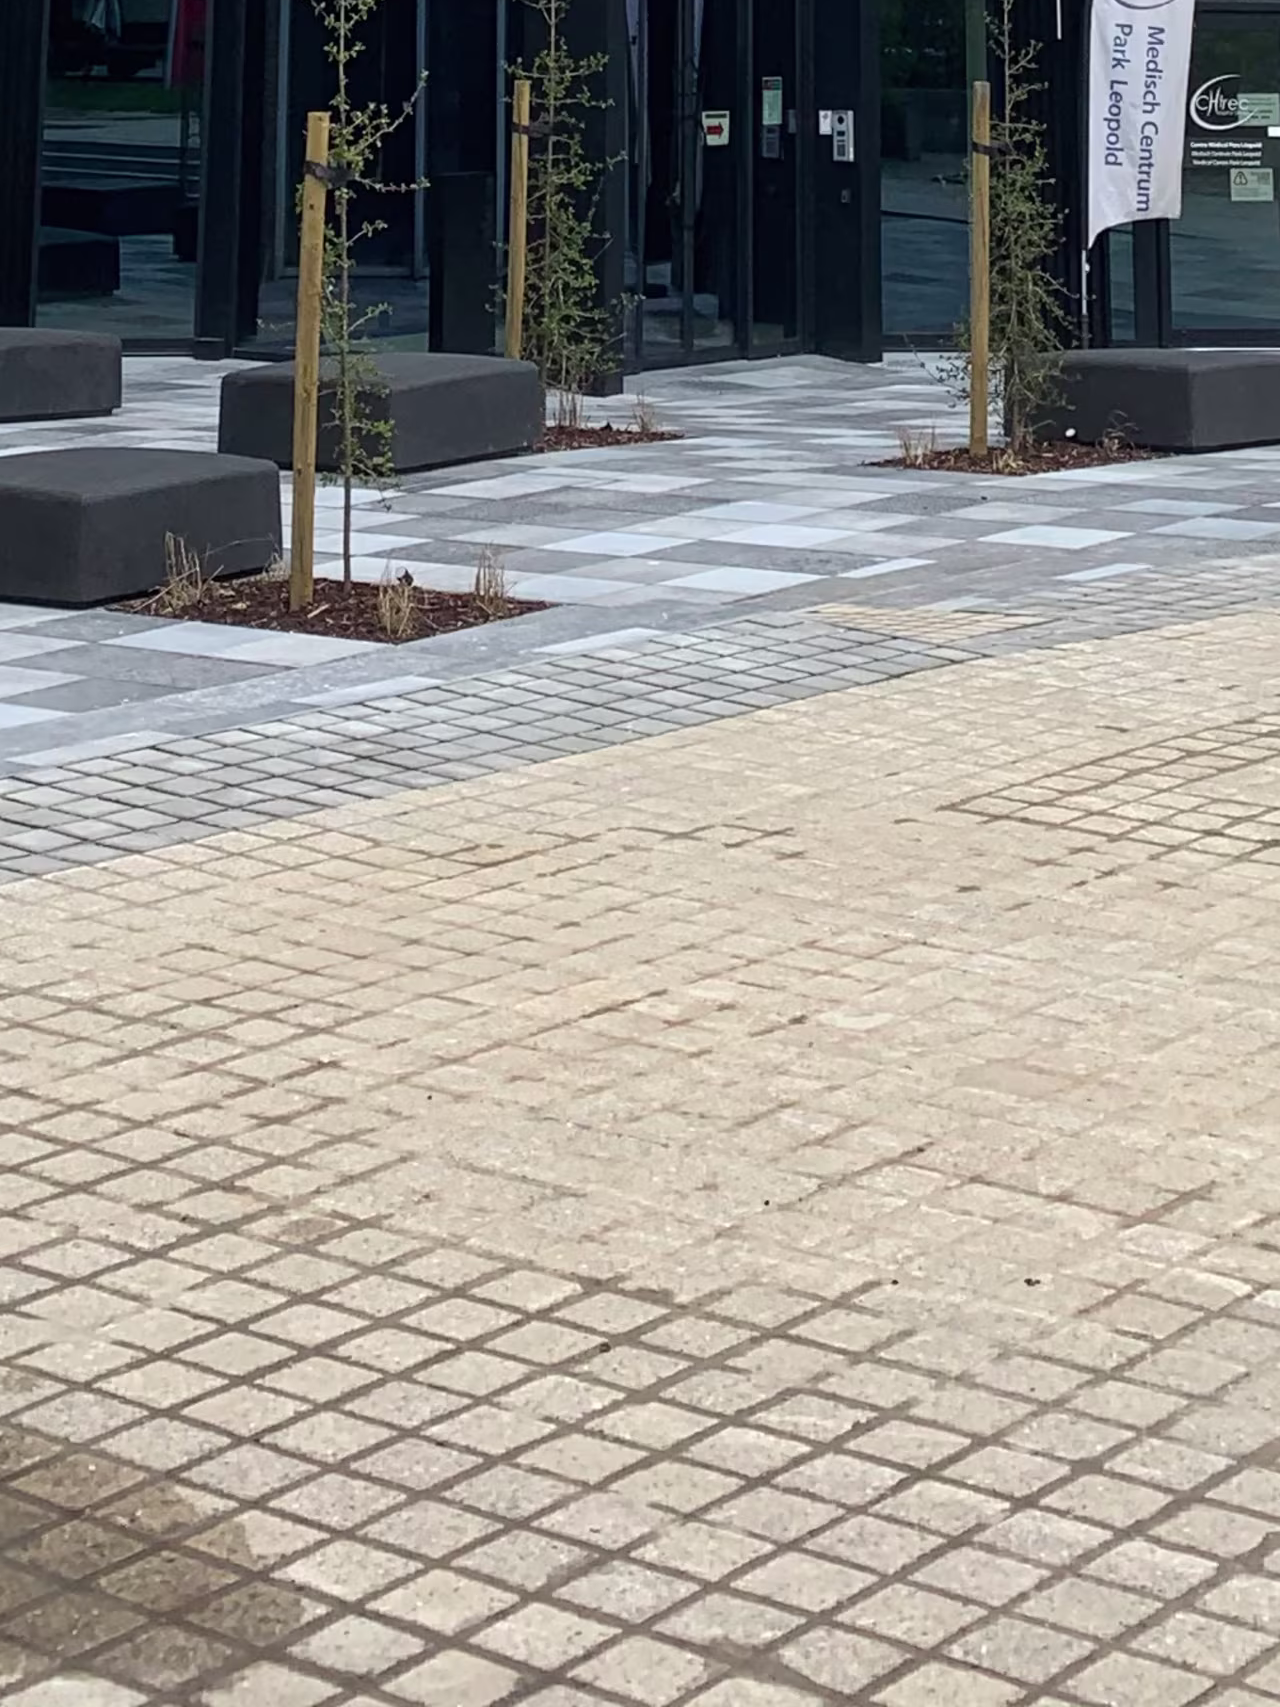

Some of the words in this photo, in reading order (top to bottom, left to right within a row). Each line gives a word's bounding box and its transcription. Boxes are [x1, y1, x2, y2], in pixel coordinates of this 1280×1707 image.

[1111, 23, 1133, 70] Park
[1142, 25, 1165, 114] Medisch
[1103, 79, 1129, 167] Leopold
[1136, 120, 1159, 213] Centrum
